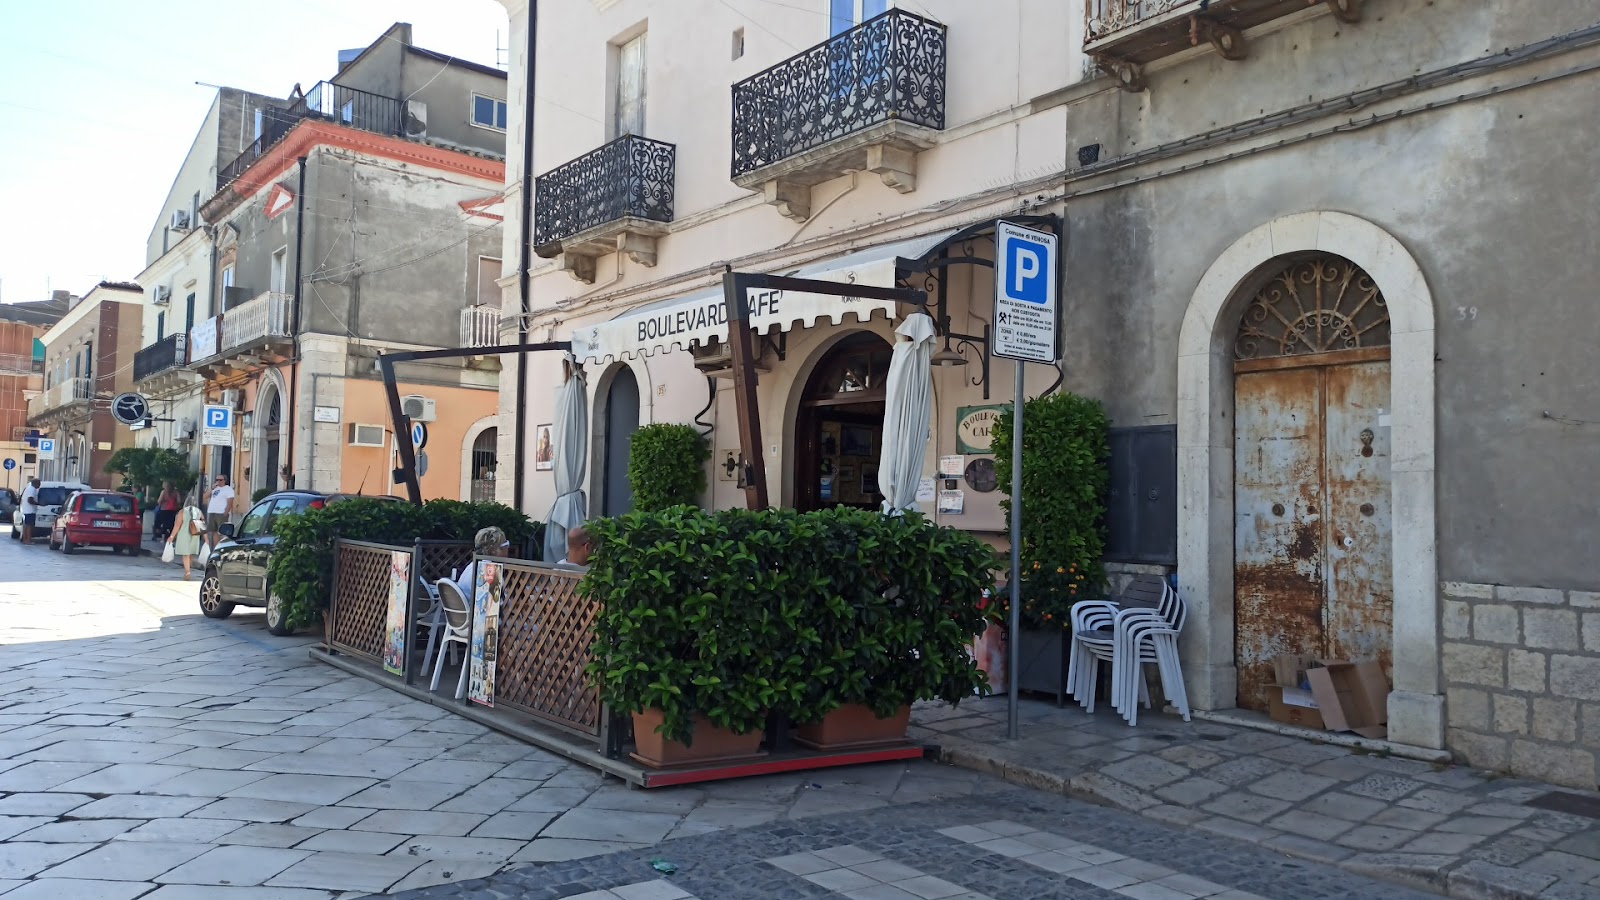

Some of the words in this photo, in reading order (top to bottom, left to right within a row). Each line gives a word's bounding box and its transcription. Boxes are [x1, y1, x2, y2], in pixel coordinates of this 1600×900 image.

[1005, 228, 1024, 238] Comune
[1031, 235, 1051, 245] VENOSA
[1015, 246, 1040, 292] P
[638, 302, 728, 342] BOULEVARD
[748, 290, 784, 317] AFE'
[1031, 305, 1052, 313] PAGAMENTO
[1457, 306, 1478, 321] 39
[211, 410, 225, 426] P
[963, 412, 997, 430] BOULEV
[973, 427, 992, 437] CAF
[43, 441, 50, 450] P
